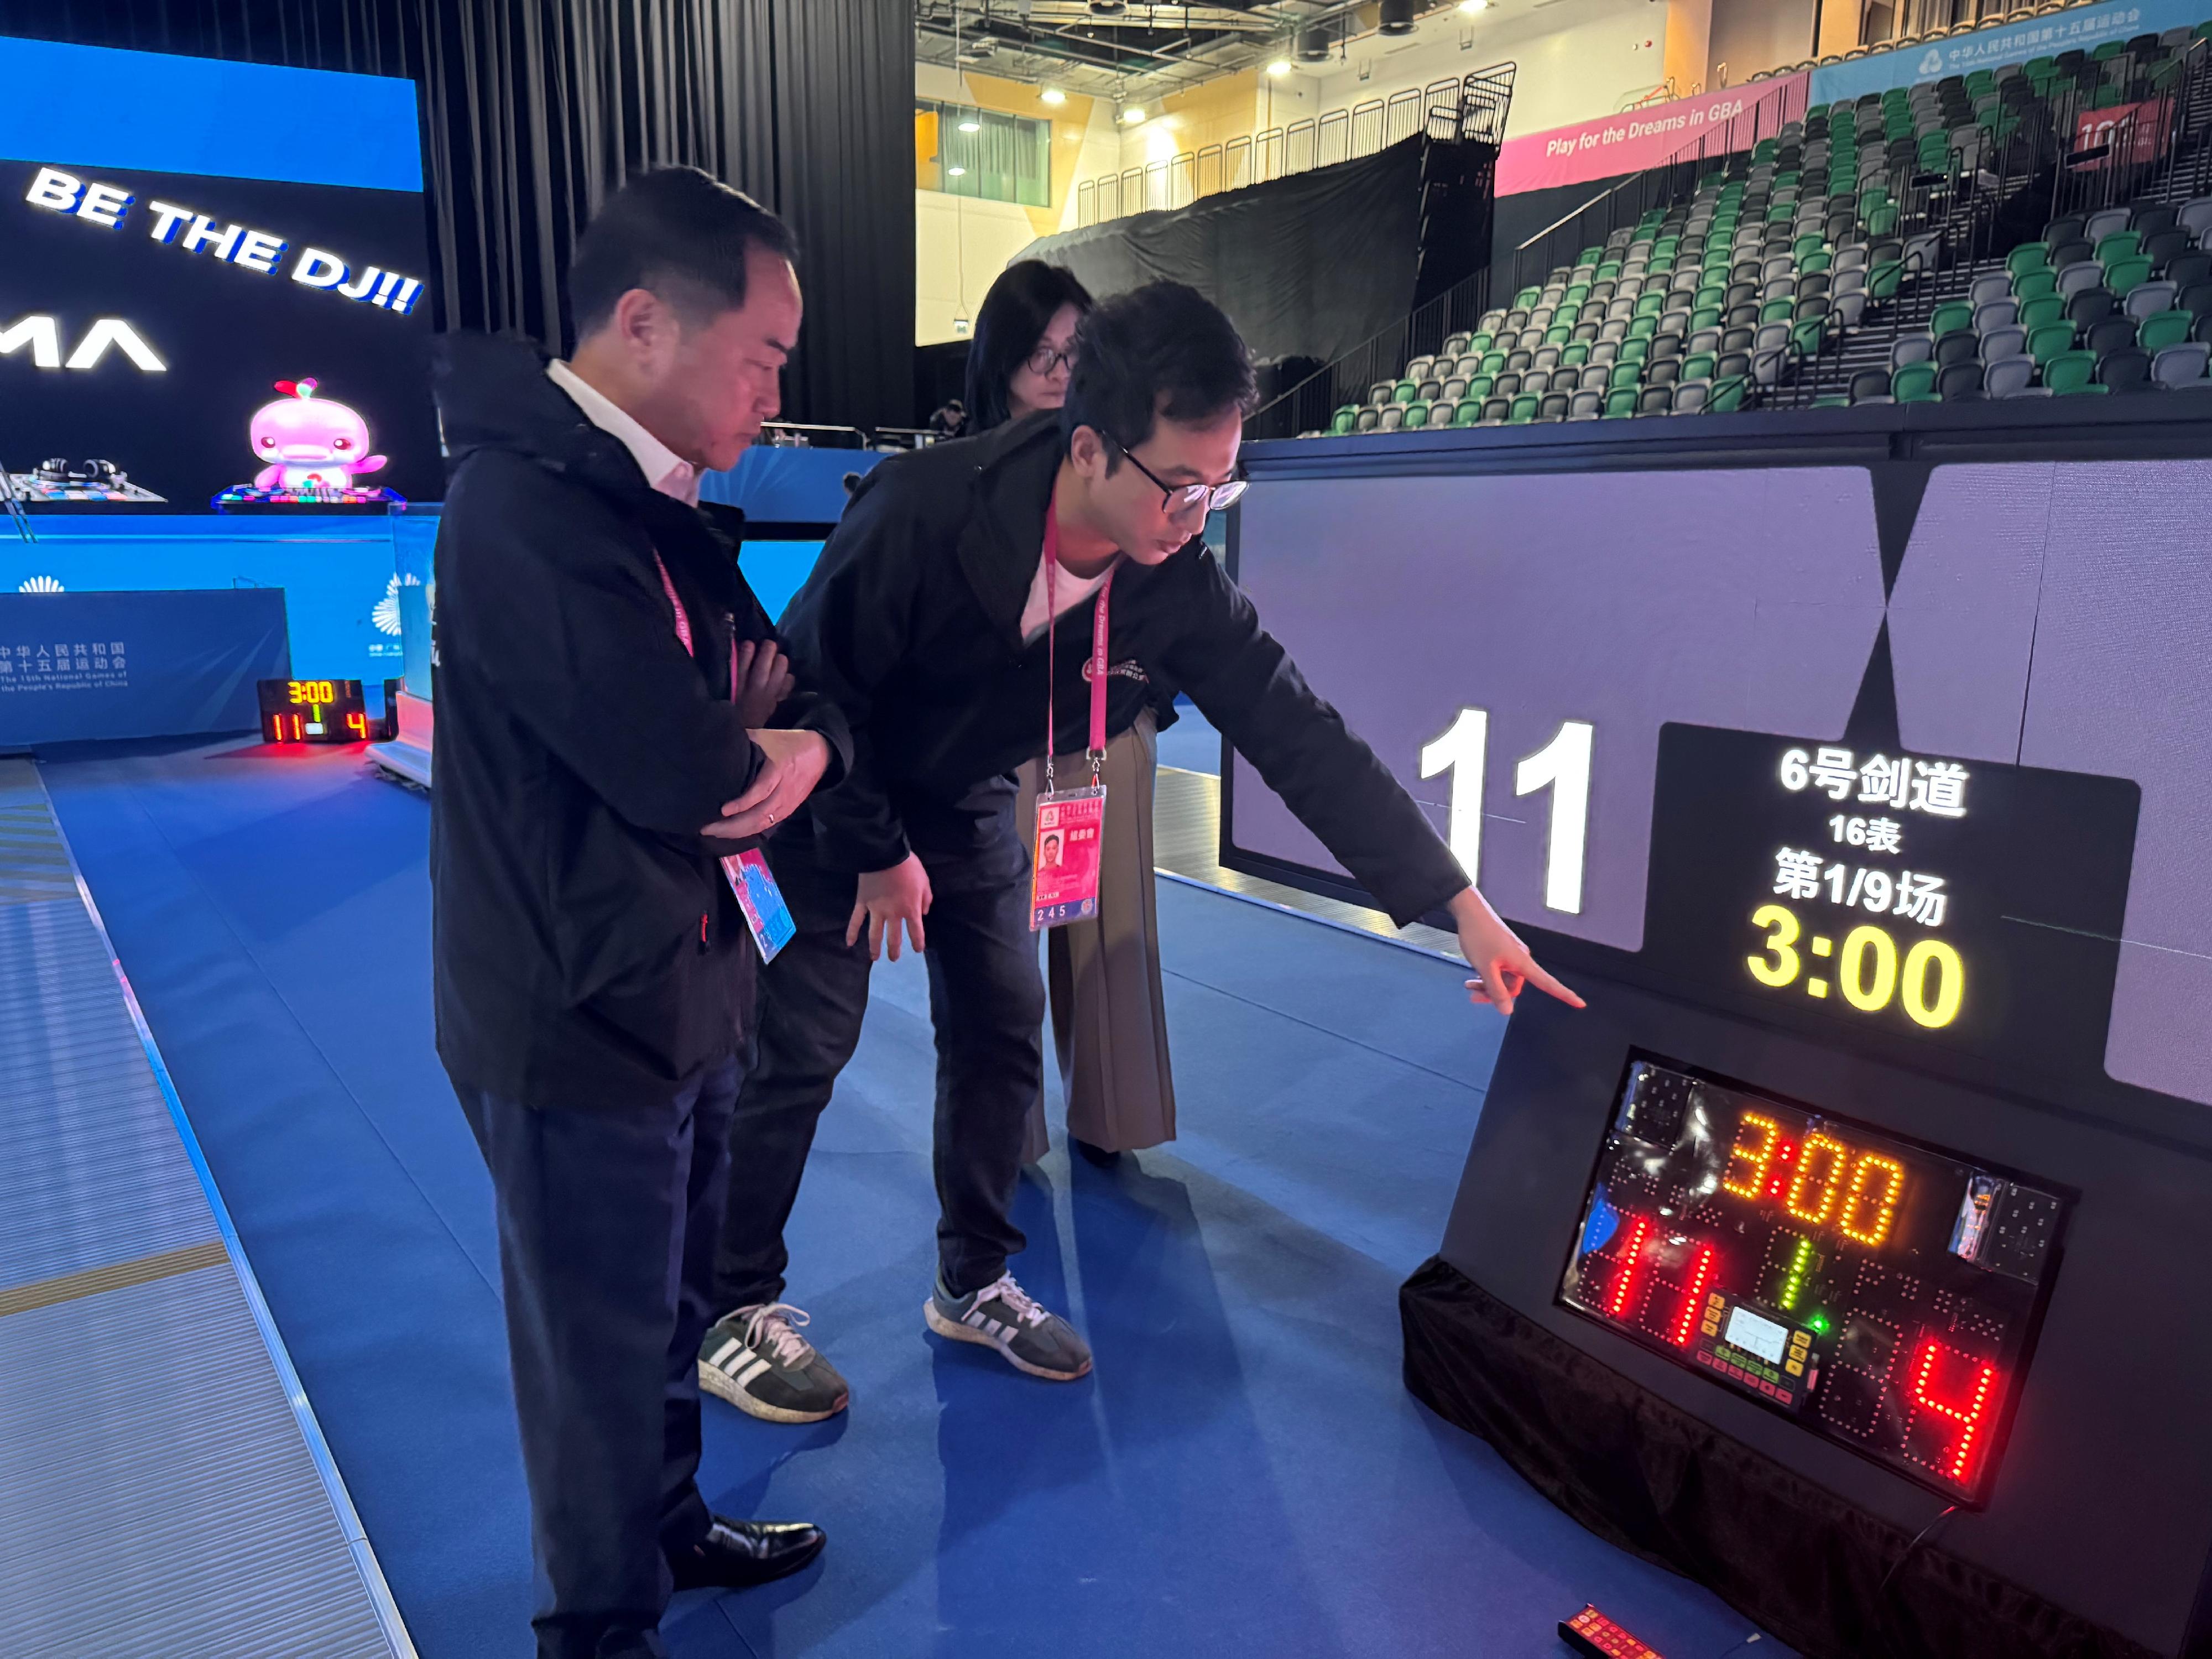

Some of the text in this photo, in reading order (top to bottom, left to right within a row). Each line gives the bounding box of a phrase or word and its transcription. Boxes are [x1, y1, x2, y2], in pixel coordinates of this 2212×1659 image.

[1546, 100, 1743, 157] Play for the Dreams in GBA
[25, 167, 424, 315] BE THE DJ!!
[0, 641, 124, 660] 中华人民共和国
[0, 656, 127, 674] 第十五届运动会
[288, 681, 333, 703] 3:00
[273, 713, 301, 740] 11
[346, 713, 366, 739] 4
[1420, 708, 1593, 915] 11
[1780, 747, 1970, 818] 6号剑道
[1829, 814, 1903, 855] 16表
[1037, 905, 1066, 921] 2 4 5
[1773, 847, 1947, 927] 第1/9场
[1747, 905, 1964, 1029] 3:00
[1722, 1111, 1905, 1247] 3:00
[1612, 1218, 1713, 1347] 11
[1914, 1340, 1995, 1479] 4
